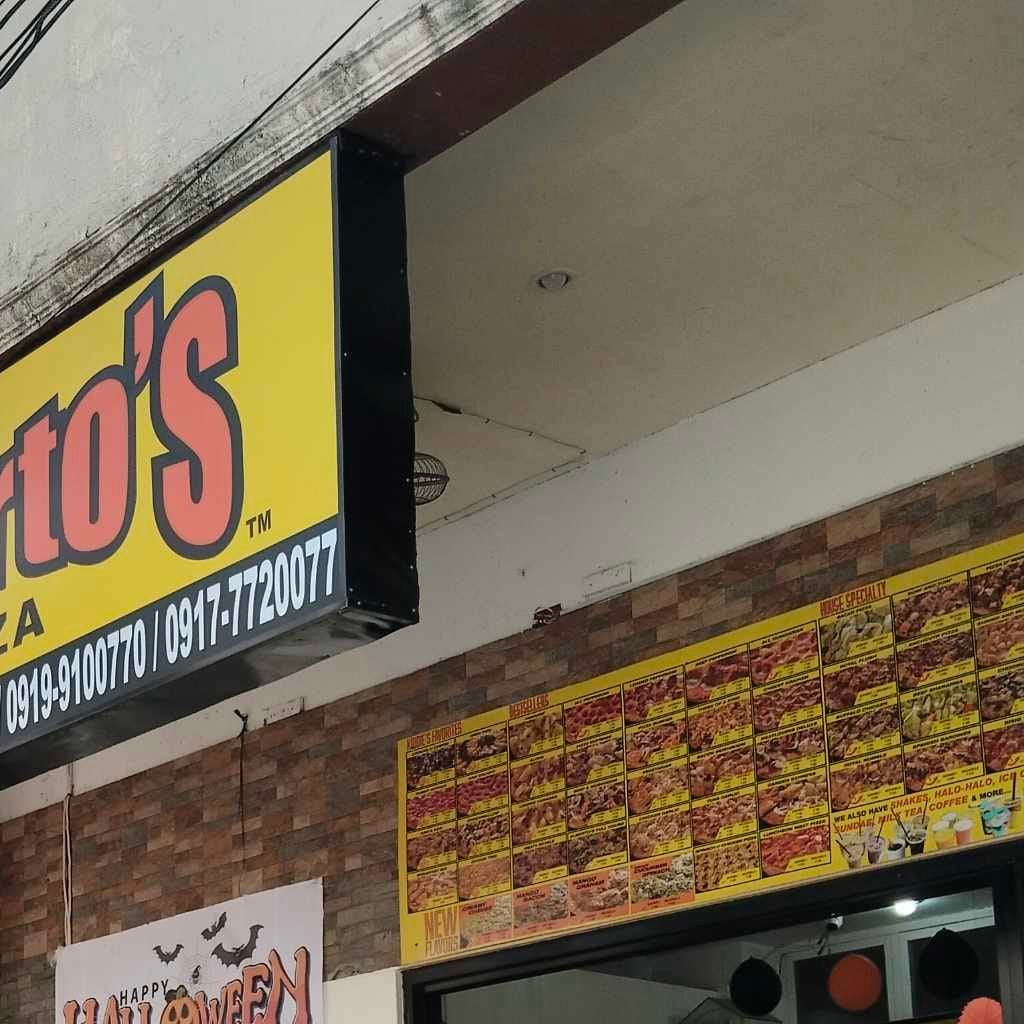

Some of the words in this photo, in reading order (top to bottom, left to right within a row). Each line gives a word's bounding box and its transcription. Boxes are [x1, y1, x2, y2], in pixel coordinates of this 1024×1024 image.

[246, 511, 272, 538] TM
[6, 618, 146, 734] 0919-9100770
[165, 528, 337, 664] 0917-7720077
[834, 814, 846, 823] WE
[847, 810, 867, 820] ALSO
[869, 804, 888, 815] HAVE
[929, 795, 968, 812] COFFEE
[425, 906, 458, 940] NEW
[120, 978, 169, 1006] HAPPY
